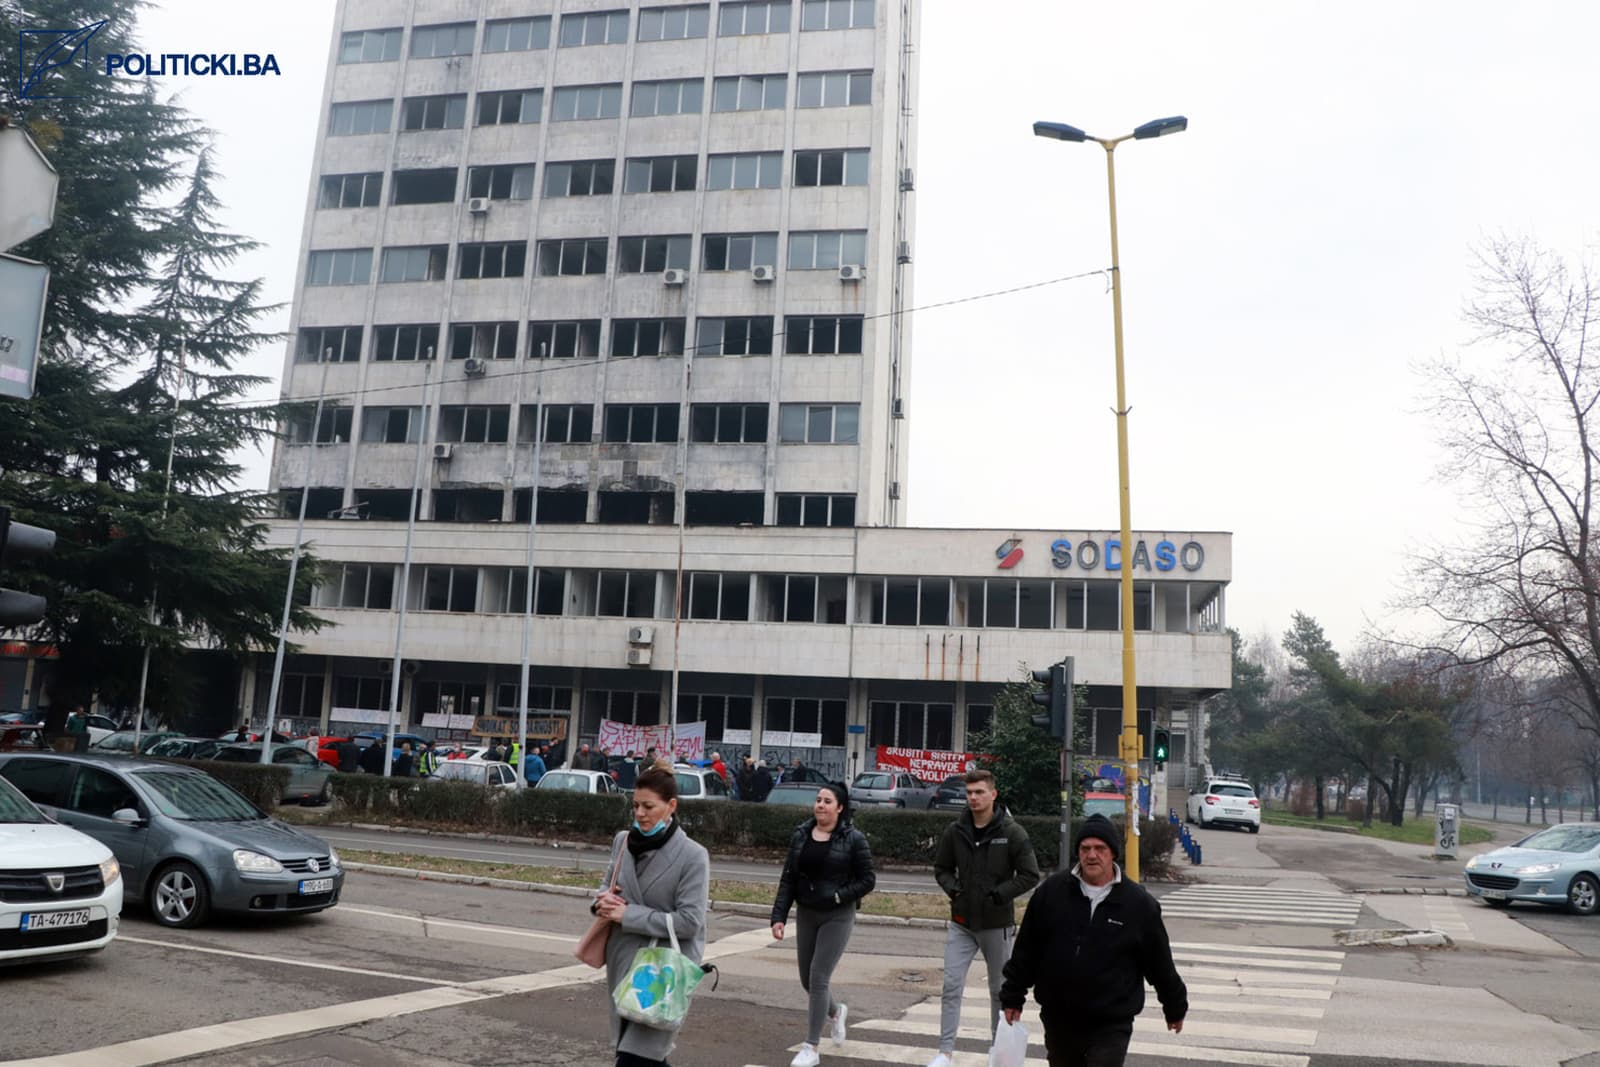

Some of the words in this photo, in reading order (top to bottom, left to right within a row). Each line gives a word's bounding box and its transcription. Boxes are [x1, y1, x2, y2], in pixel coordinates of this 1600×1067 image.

[1051, 539, 1204, 572] SODASO
[602, 720, 672, 738] SMRT
[600, 733, 704, 757] KAPITALZMU
[931, 751, 966, 761] SISTEM
[909, 758, 959, 772] NEPRAVDE
[30, 912, 88, 928] TA-477176
